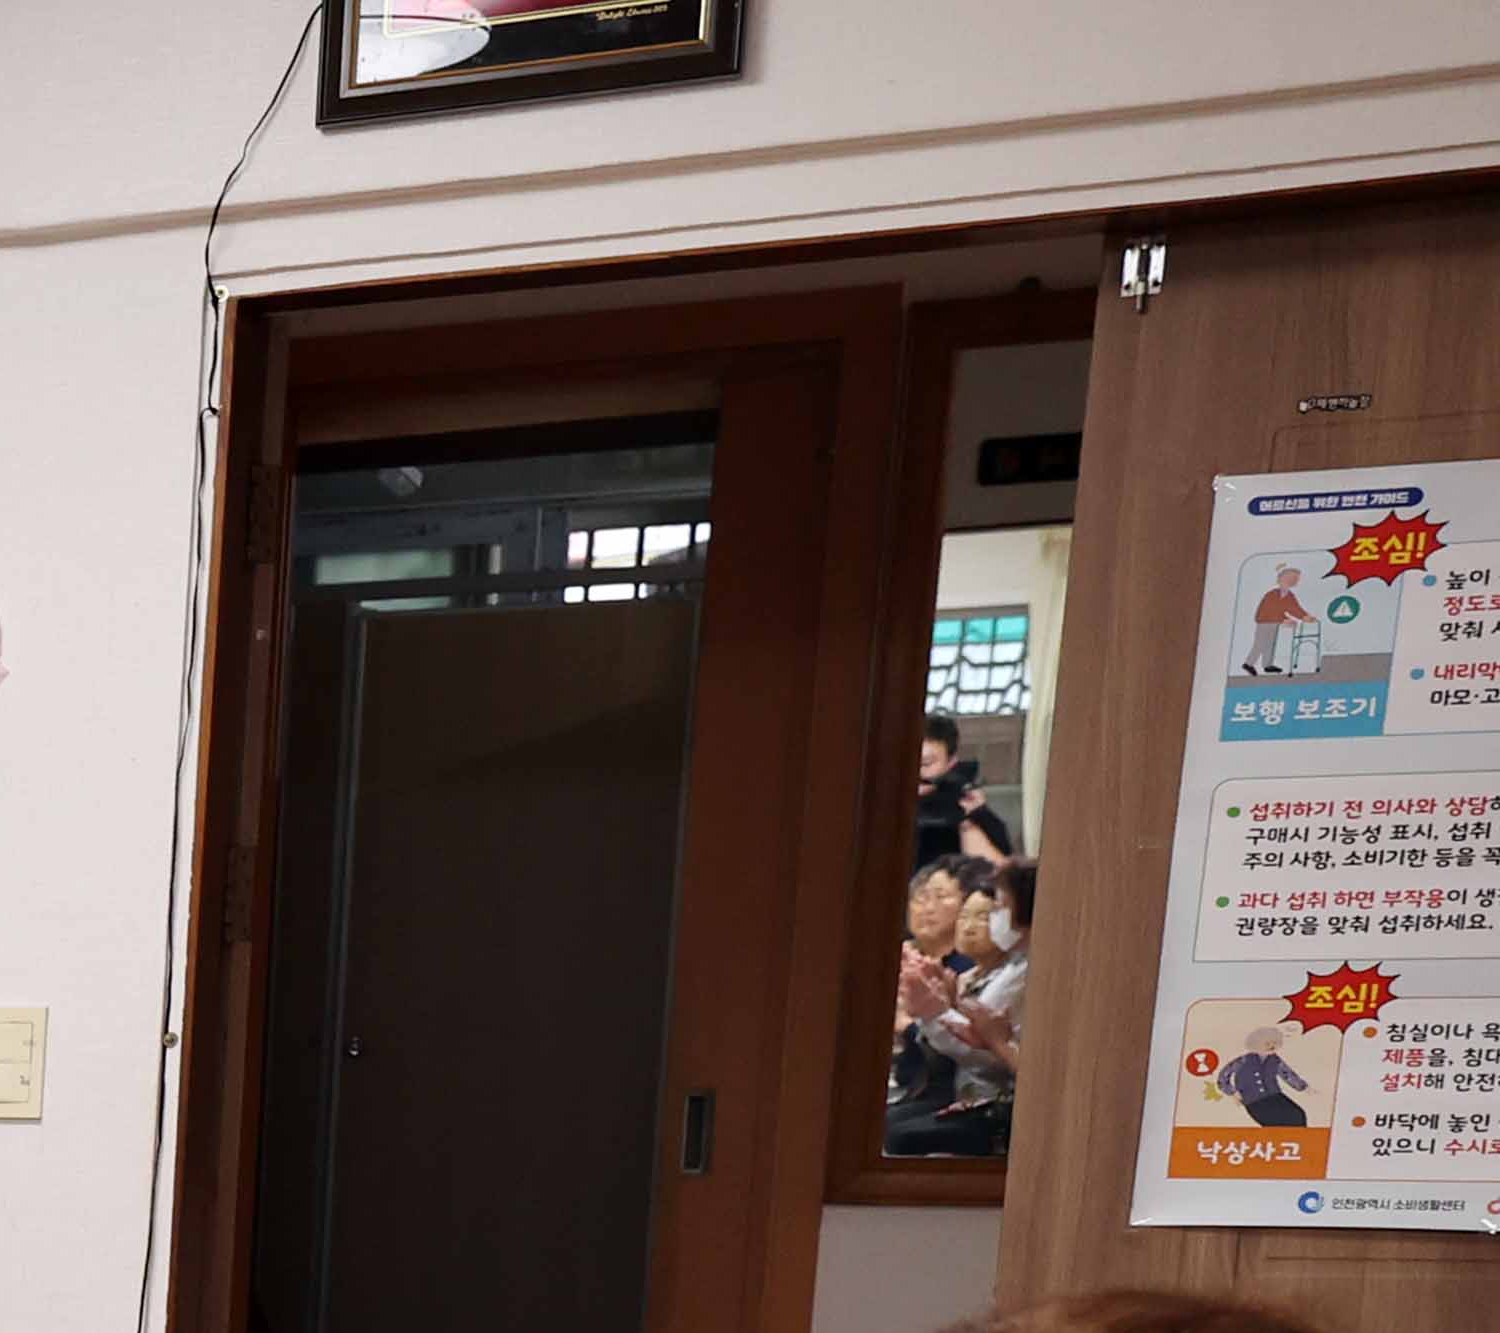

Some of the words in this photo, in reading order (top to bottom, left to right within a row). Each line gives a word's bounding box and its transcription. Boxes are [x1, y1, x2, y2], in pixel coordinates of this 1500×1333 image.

[1350, 531, 1428, 565] 조심!
[1445, 568, 1492, 591] 높이
[1439, 620, 1483, 643] 맞춰
[1230, 699, 1285, 726] 보행
[1294, 697, 1377, 720] 보조기
[1249, 801, 1335, 822] 섭취하기
[1342, 799, 1363, 820] 전
[1371, 798, 1437, 817] 의사와
[1245, 827, 1310, 846] 구매시
[1317, 824, 1382, 845] 기능성
[1448, 821, 1492, 842] 섭취
[1242, 851, 1284, 871] 주의
[1342, 849, 1428, 869] 소비기한
[1433, 847, 1477, 868] 등을
[1237, 891, 1280, 910] 과다
[1287, 891, 1327, 911] 섭취
[1334, 890, 1375, 910] 하면
[1381, 888, 1468, 909] 부작용이
[1327, 915, 1370, 935] 맞춰
[1378, 913, 1494, 934] 섭취하세요.
[1304, 983, 1379, 1014] 조심!
[1386, 1022, 1475, 1043] 침실이나
[1380, 1072, 1445, 1092] 설치해
[1452, 1072, 1500, 1092] 안전
[1446, 1113, 1491, 1133] 놓인
[1196, 1141, 1302, 1165] 낙상사고
[1372, 1138, 1436, 1157] 있으니
